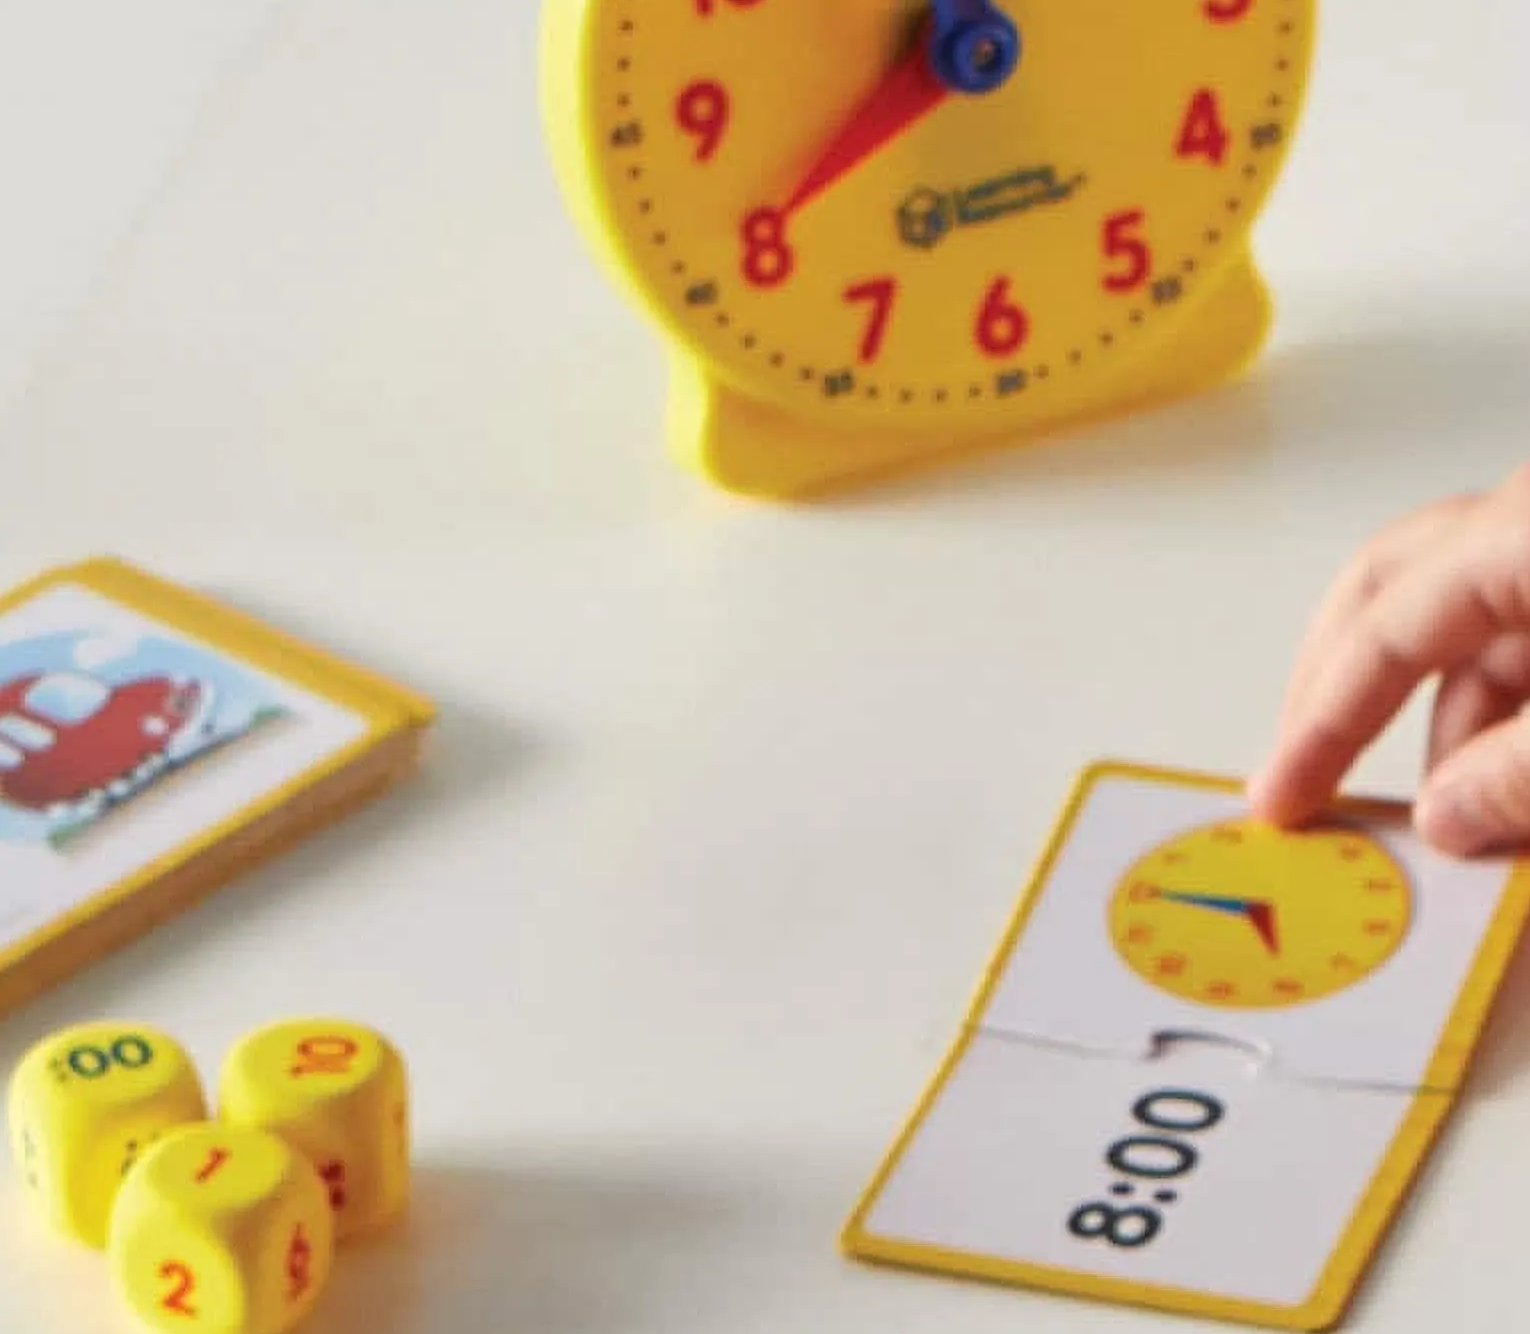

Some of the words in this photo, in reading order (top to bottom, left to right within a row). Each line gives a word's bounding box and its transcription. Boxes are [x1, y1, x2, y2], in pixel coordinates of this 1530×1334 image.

[673, 79, 732, 162] 9
[1174, 87, 1231, 165] 4
[737, 205, 795, 289] 8
[1101, 208, 1153, 294] 5
[842, 276, 898, 364] 7
[972, 276, 1030, 358] 6
[289, 1035, 361, 1078] 10
[1066, 1089, 1225, 1249] 8:00
[158, 1259, 198, 1318] 2
